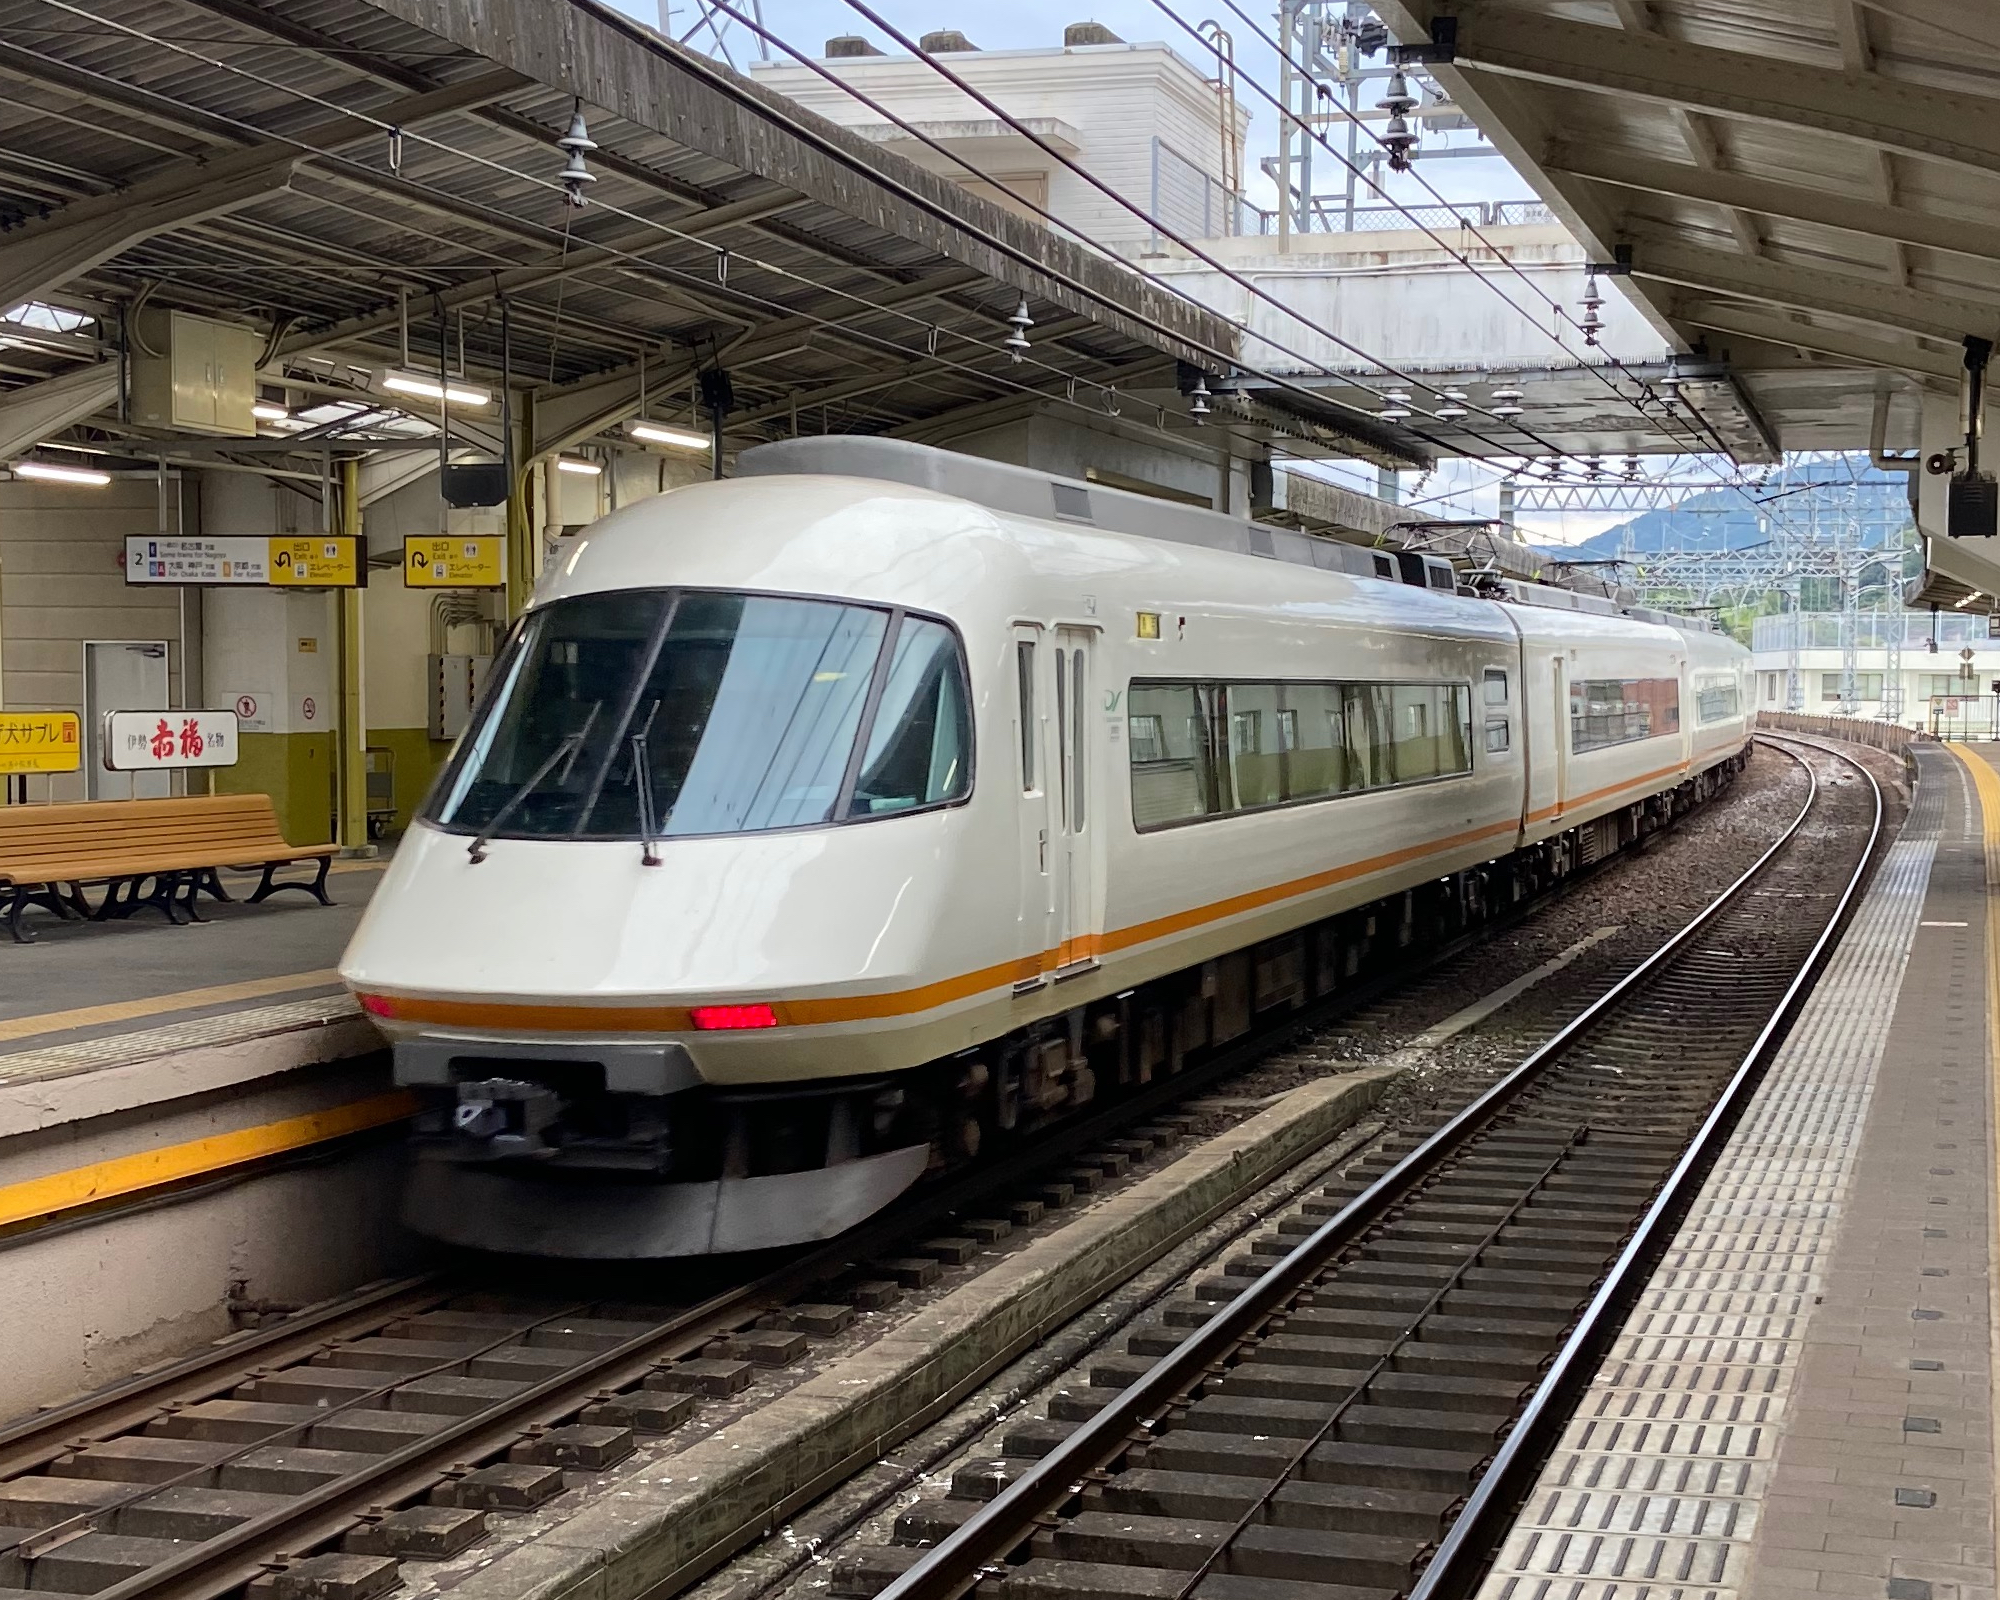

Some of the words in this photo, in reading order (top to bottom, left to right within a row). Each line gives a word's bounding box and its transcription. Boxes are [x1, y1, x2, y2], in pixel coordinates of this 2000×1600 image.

[293, 542, 310, 552] 出口
[431, 541, 450, 552] 出口
[134, 552, 143, 566] 2
[204, 552, 227, 560] Nagoya
[293, 552, 308, 560] Exit
[432, 552, 447, 560] Exit
[168, 561, 183, 570] 大阪
[309, 563, 350, 571] エレベーター
[449, 563, 492, 571] エレベーター
[309, 571, 334, 579] Elevator
[448, 571, 474, 579] Elevator
[127, 733, 147, 751] 伊勢
[150, 717, 204, 761] 赤福
[207, 732, 224, 748] 名物
